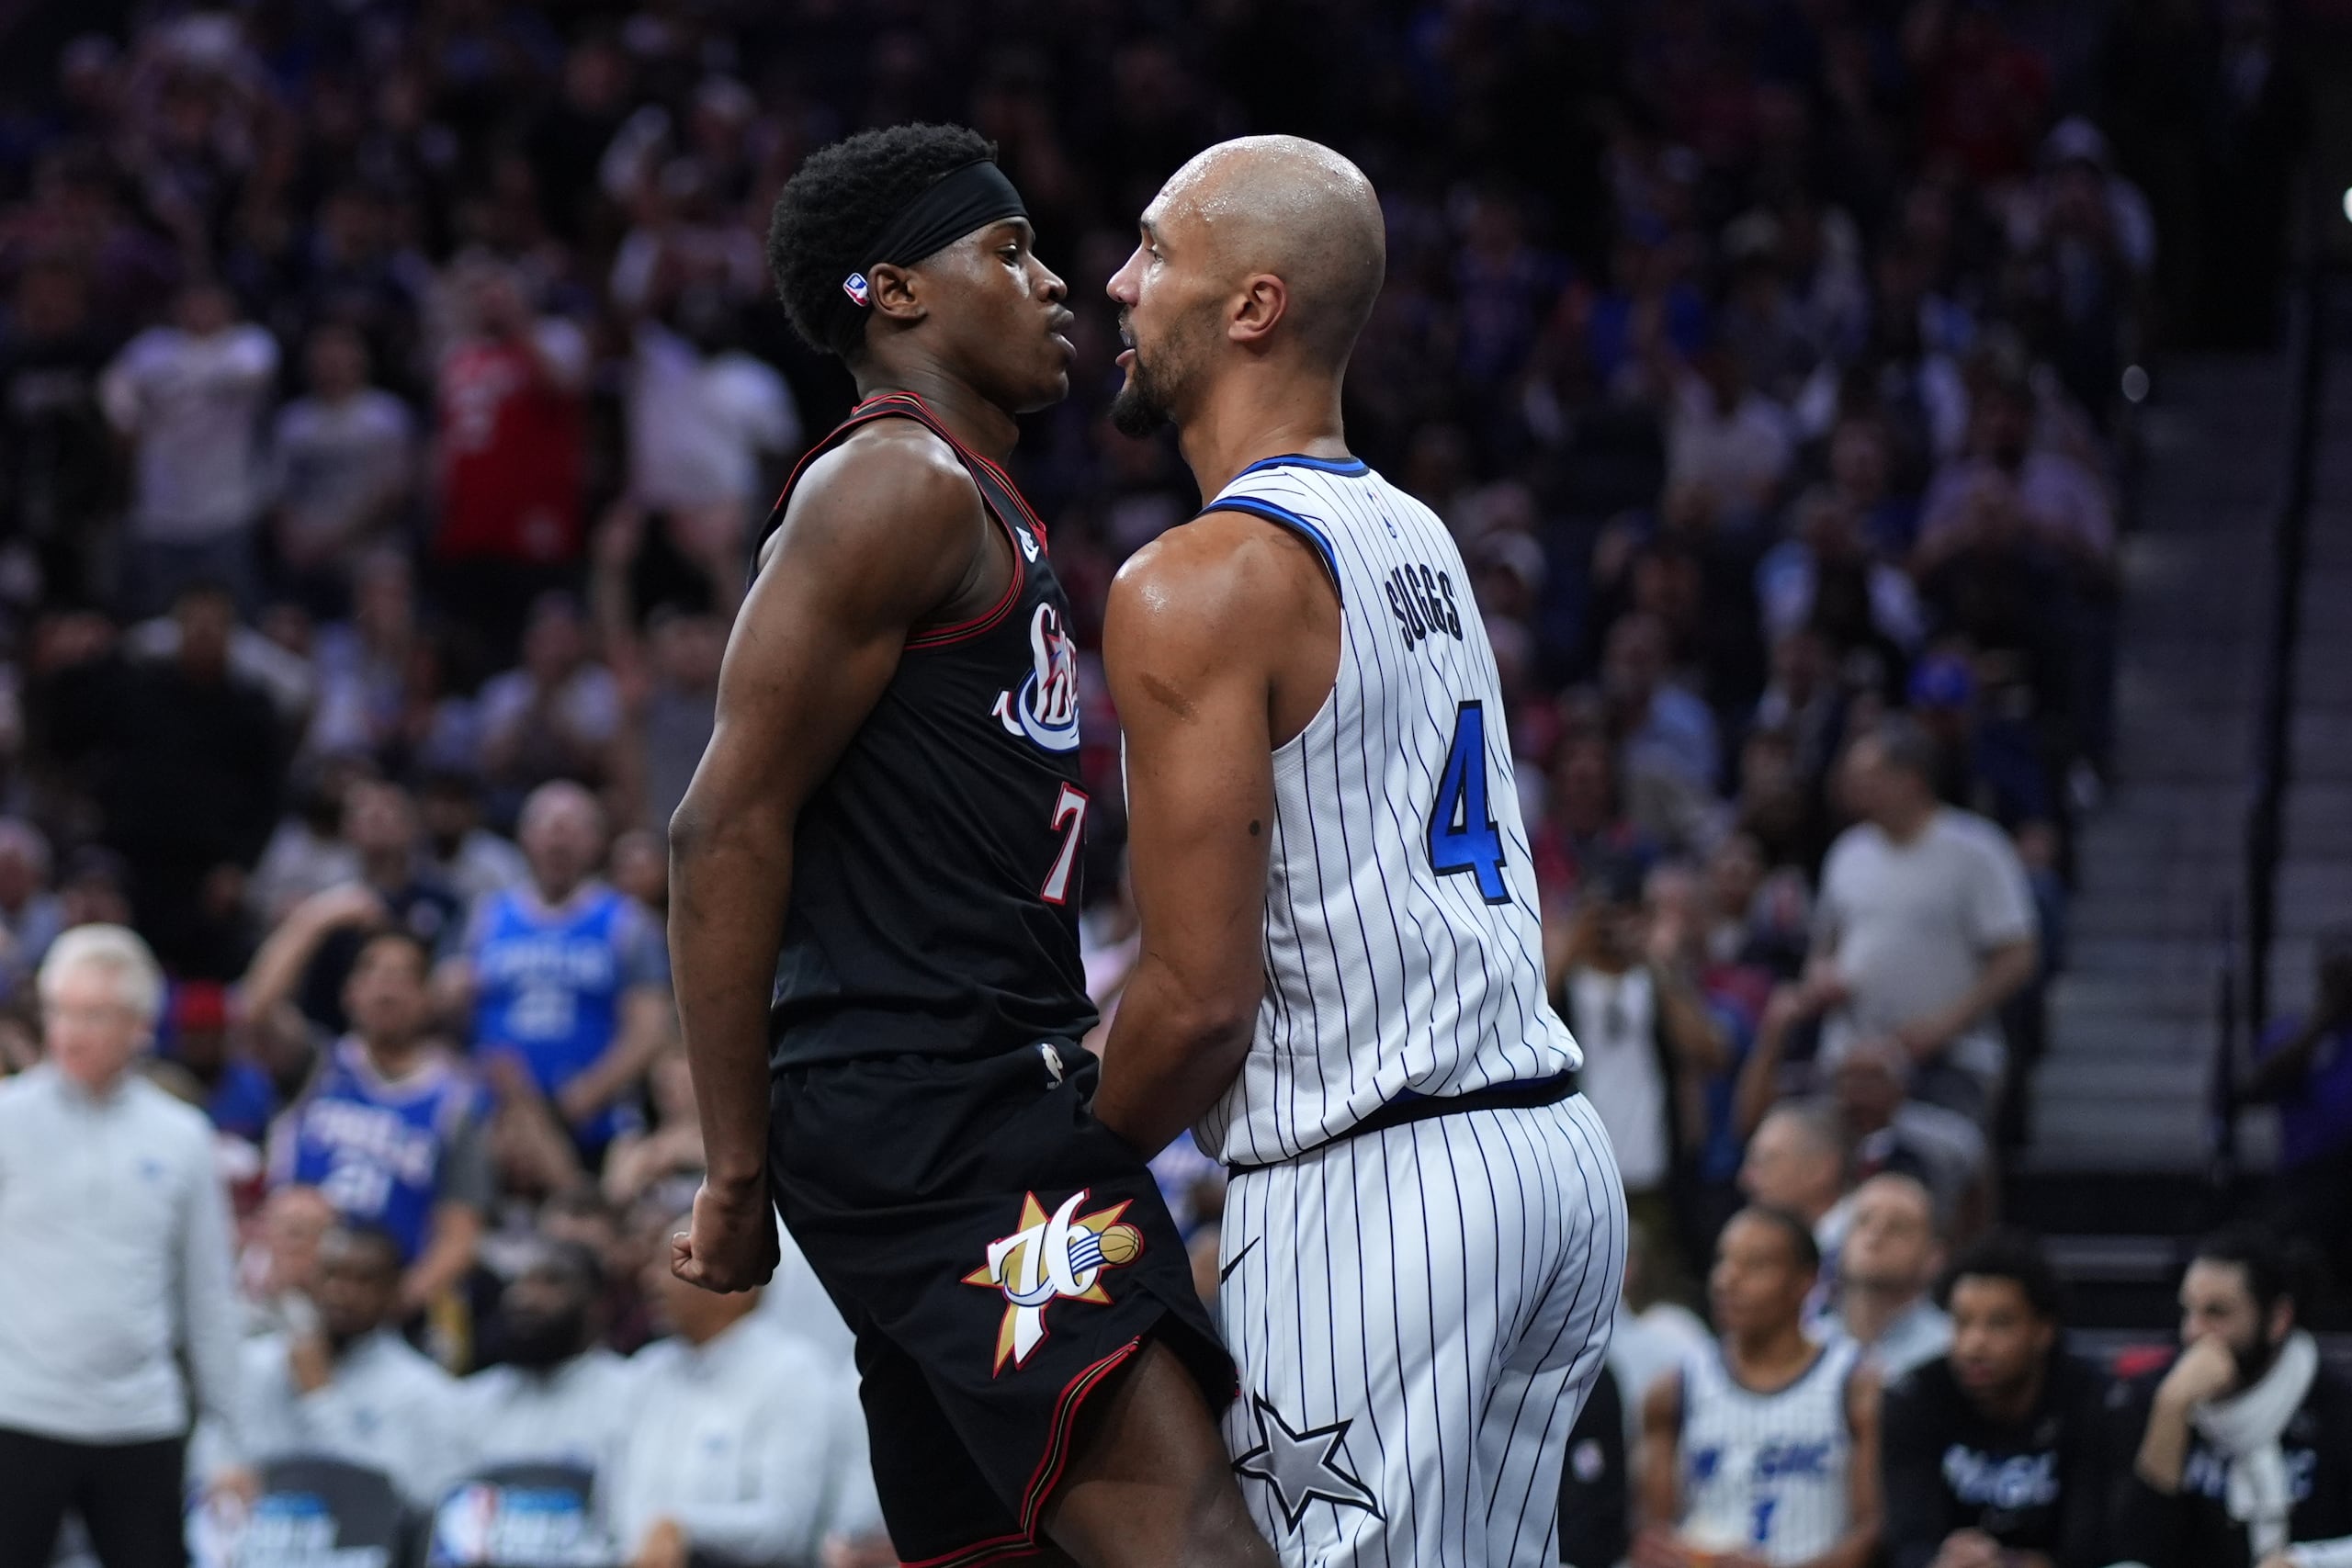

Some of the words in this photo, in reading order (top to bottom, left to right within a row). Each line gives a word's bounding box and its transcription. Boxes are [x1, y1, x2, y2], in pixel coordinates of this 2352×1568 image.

[1385, 563, 1463, 652] SUGGS
[1041, 782, 1089, 905] 7
[1427, 699, 1511, 905] 4
[986, 1188, 1101, 1371] 76
